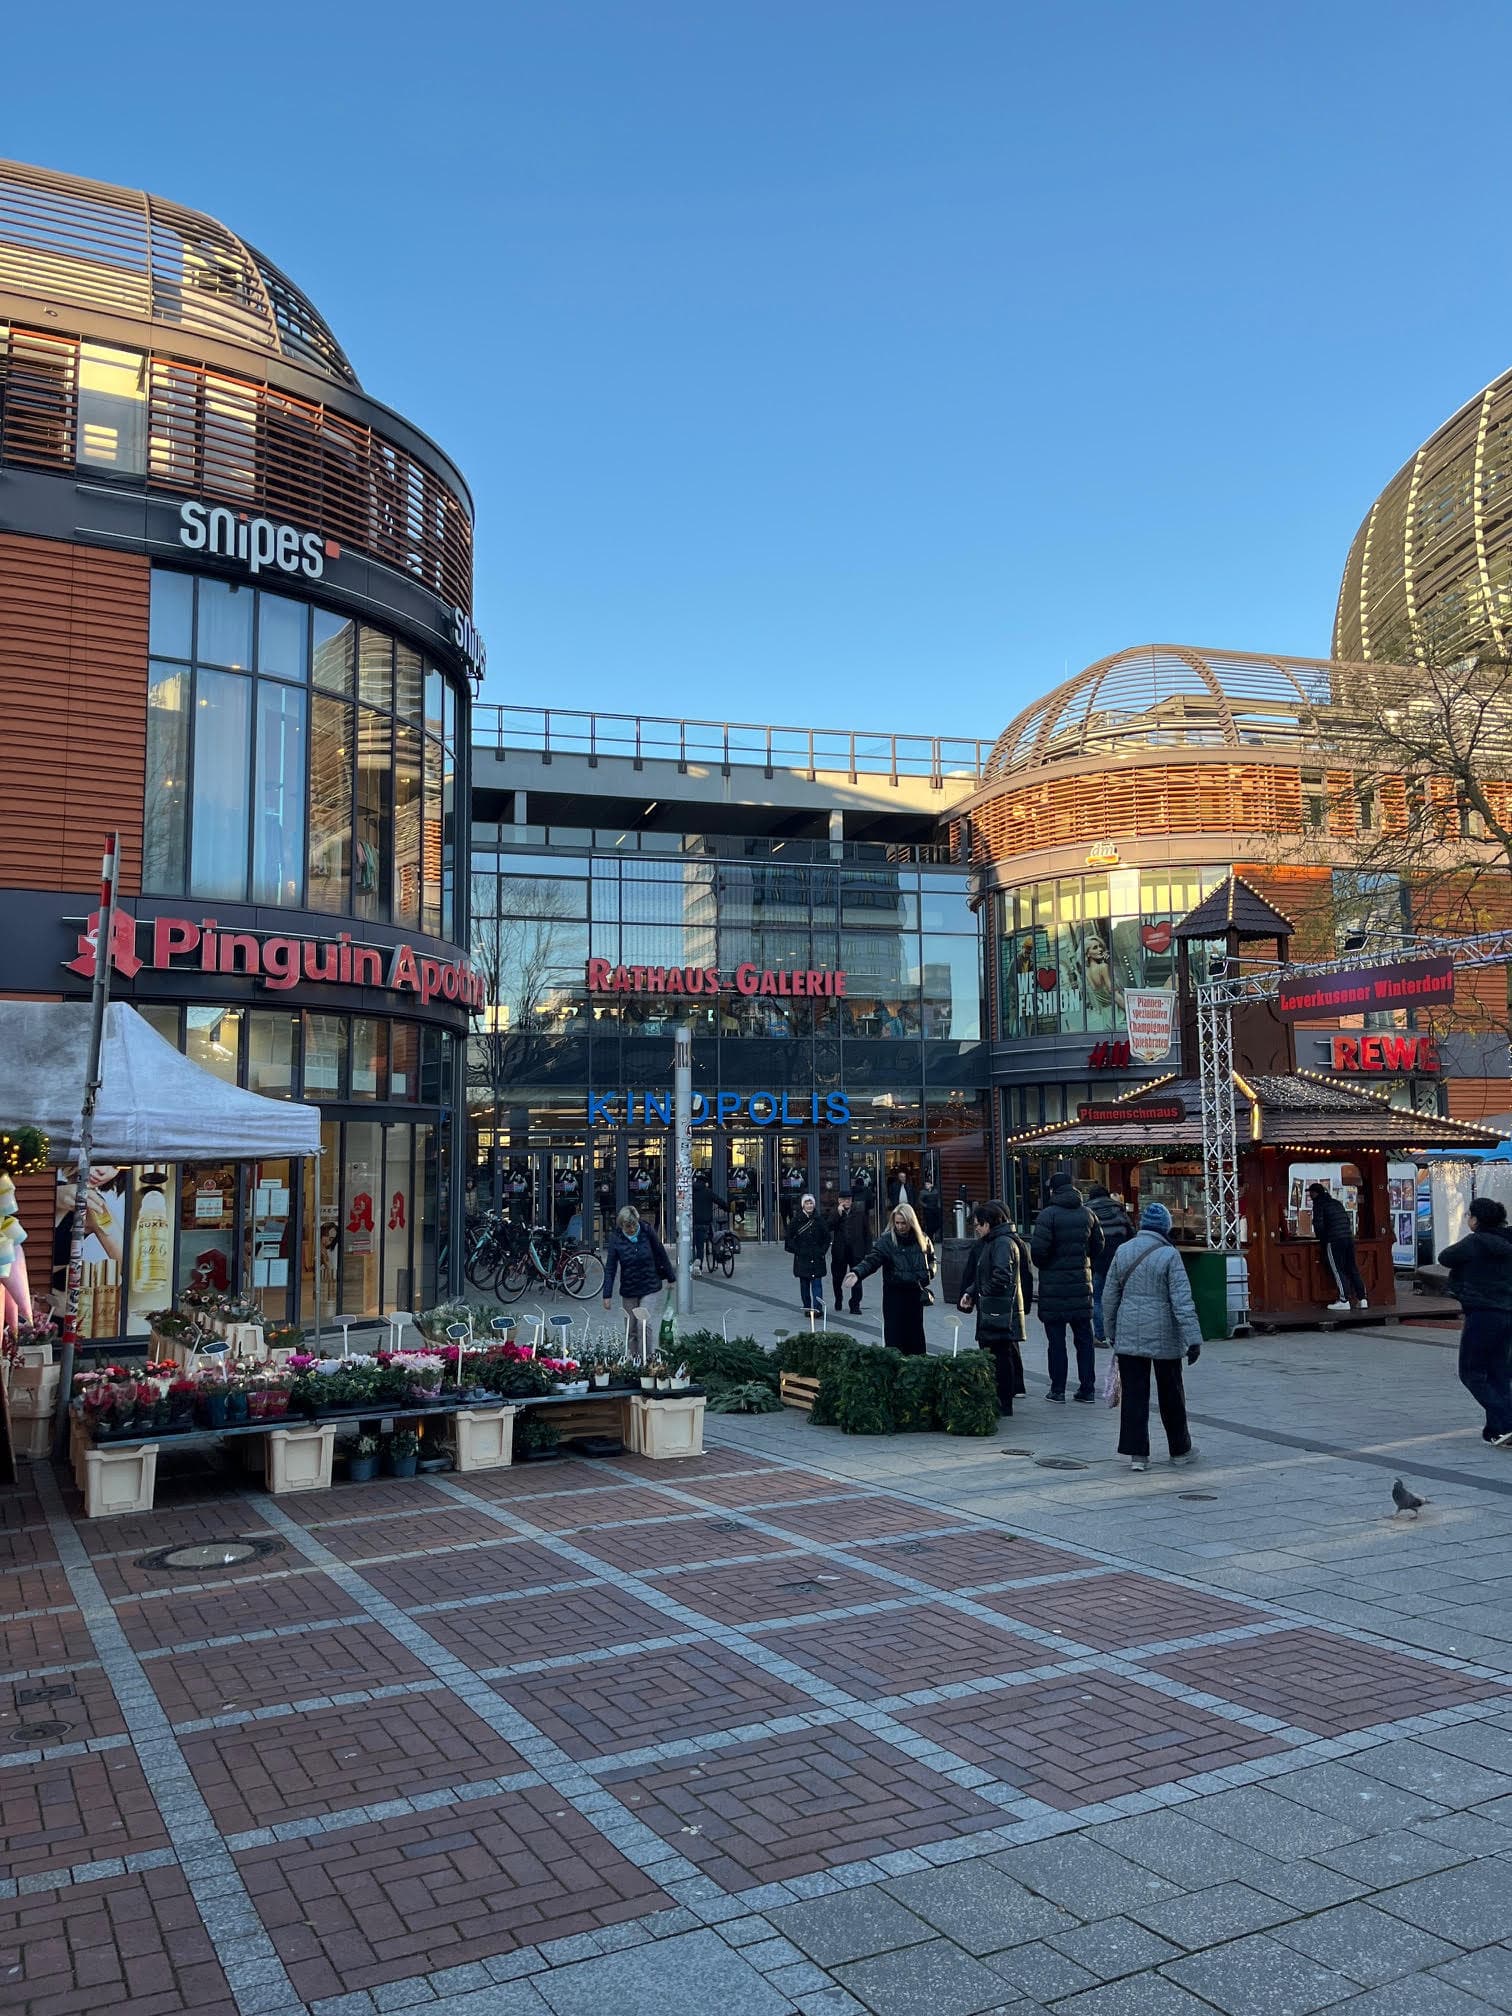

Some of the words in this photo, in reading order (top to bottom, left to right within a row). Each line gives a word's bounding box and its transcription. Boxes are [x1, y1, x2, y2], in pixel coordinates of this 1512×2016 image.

[180, 501, 323, 578] snipes
[1091, 842, 1114, 857] dm
[154, 916, 382, 990] Pinguin
[1017, 970, 1035, 995] WE
[1279, 985, 1371, 1012] Leverkusener
[1373, 970, 1454, 999] Winterdorf
[1018, 988, 1081, 1018] FASHION
[1330, 1036, 1441, 1072] REWE
[1080, 1107, 1178, 1121] Pfannenschmaus
